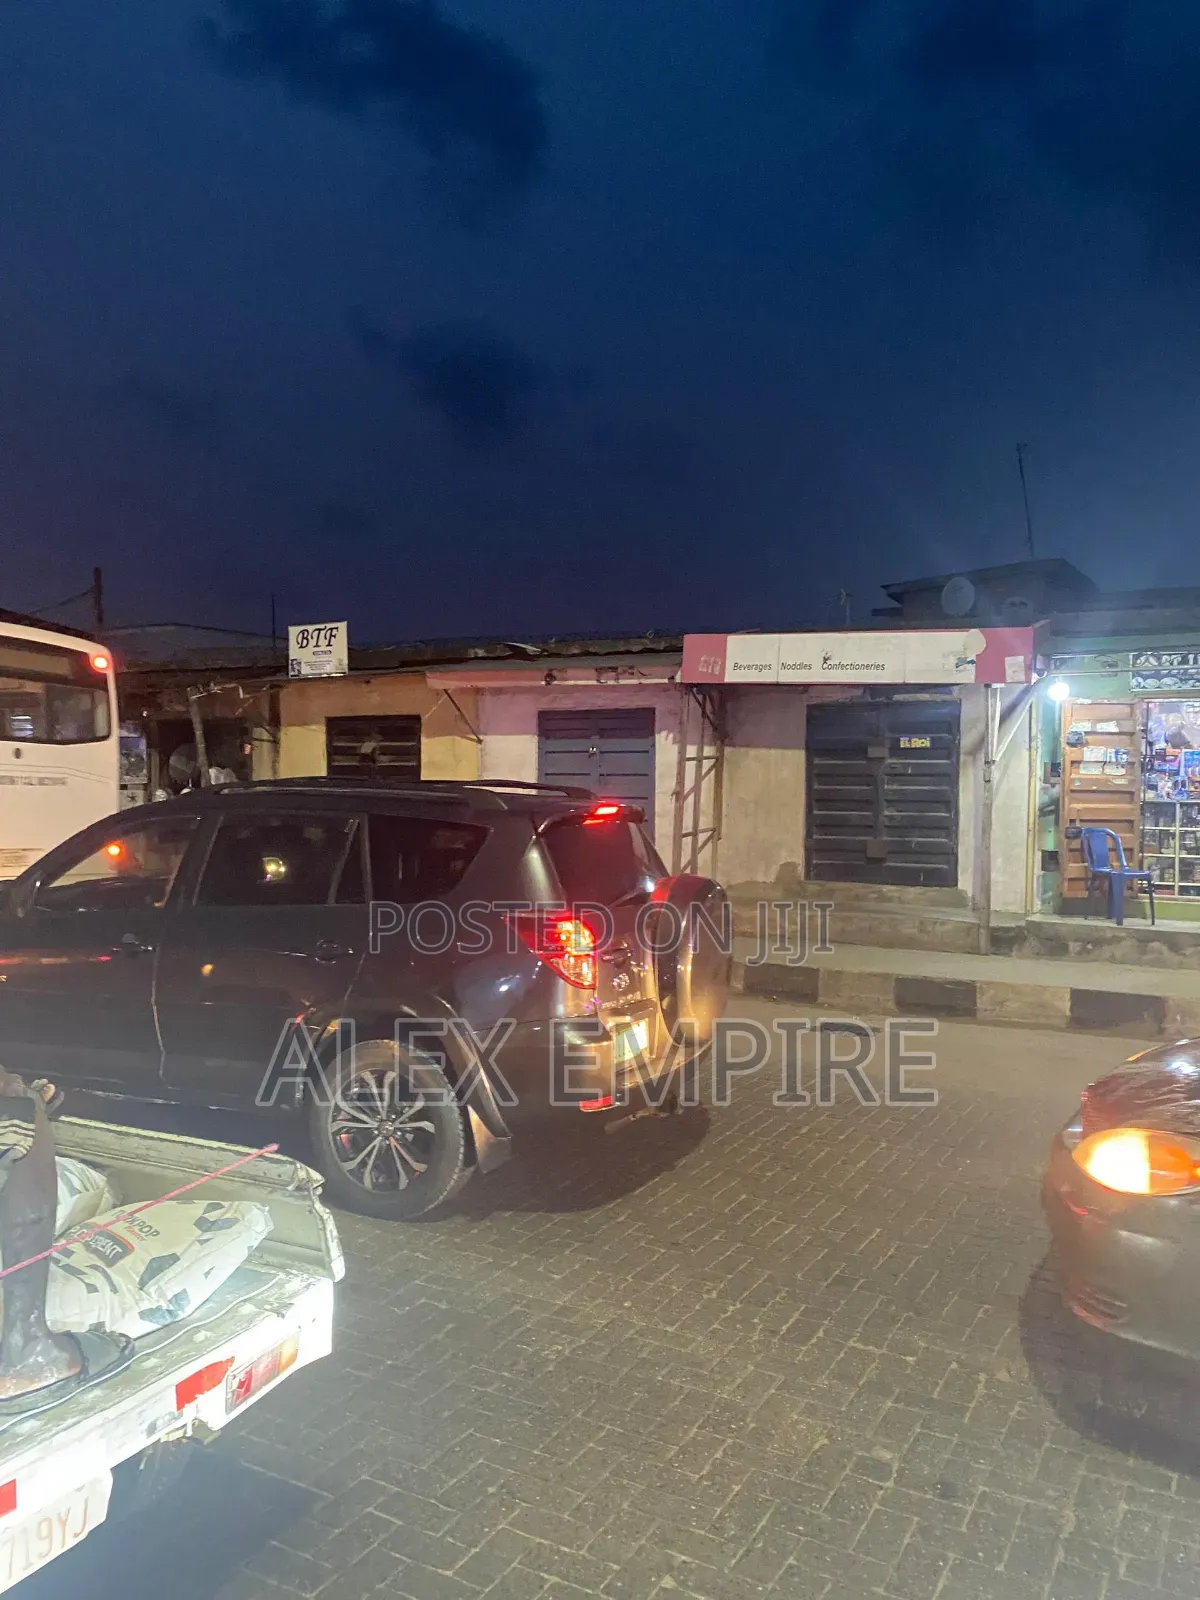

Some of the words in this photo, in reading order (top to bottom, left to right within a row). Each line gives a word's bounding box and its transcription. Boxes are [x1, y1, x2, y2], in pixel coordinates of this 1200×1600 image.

[296, 625, 339, 649] BTF
[733, 662, 772, 673] Beverages
[780, 662, 812, 671] Noddles
[821, 661, 886, 671] Confectioneries
